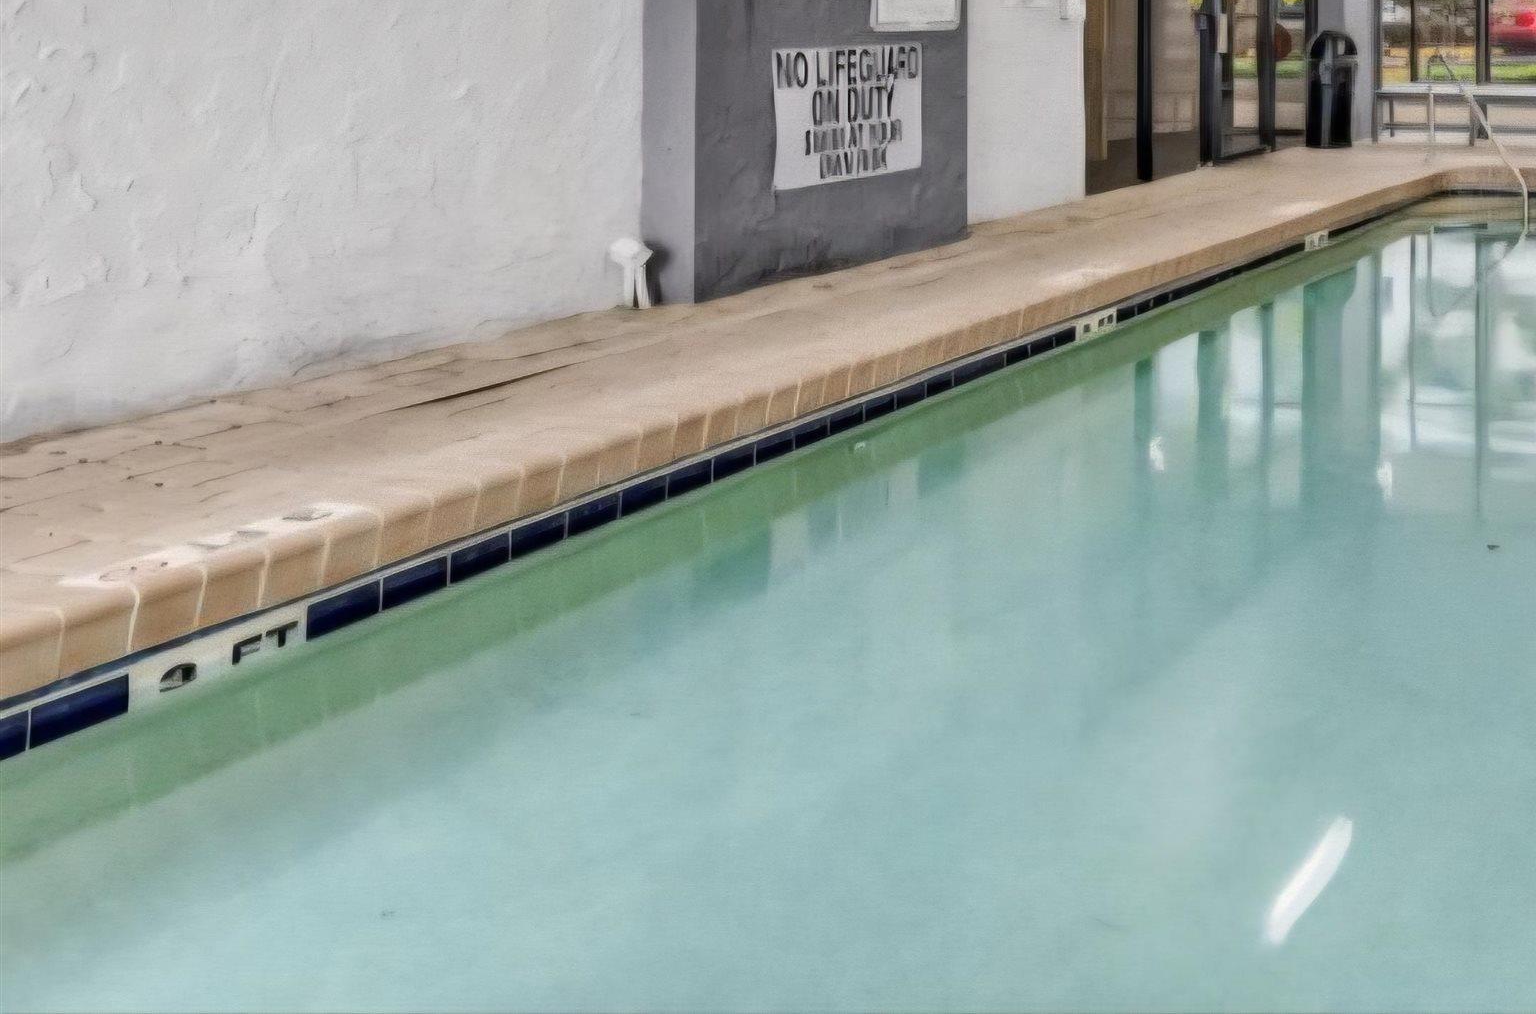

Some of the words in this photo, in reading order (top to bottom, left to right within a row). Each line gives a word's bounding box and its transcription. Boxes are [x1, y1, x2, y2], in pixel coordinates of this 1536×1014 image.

[776, 51, 808, 89] NO
[847, 85, 894, 123] DUTY
[231, 620, 299, 666] FT
